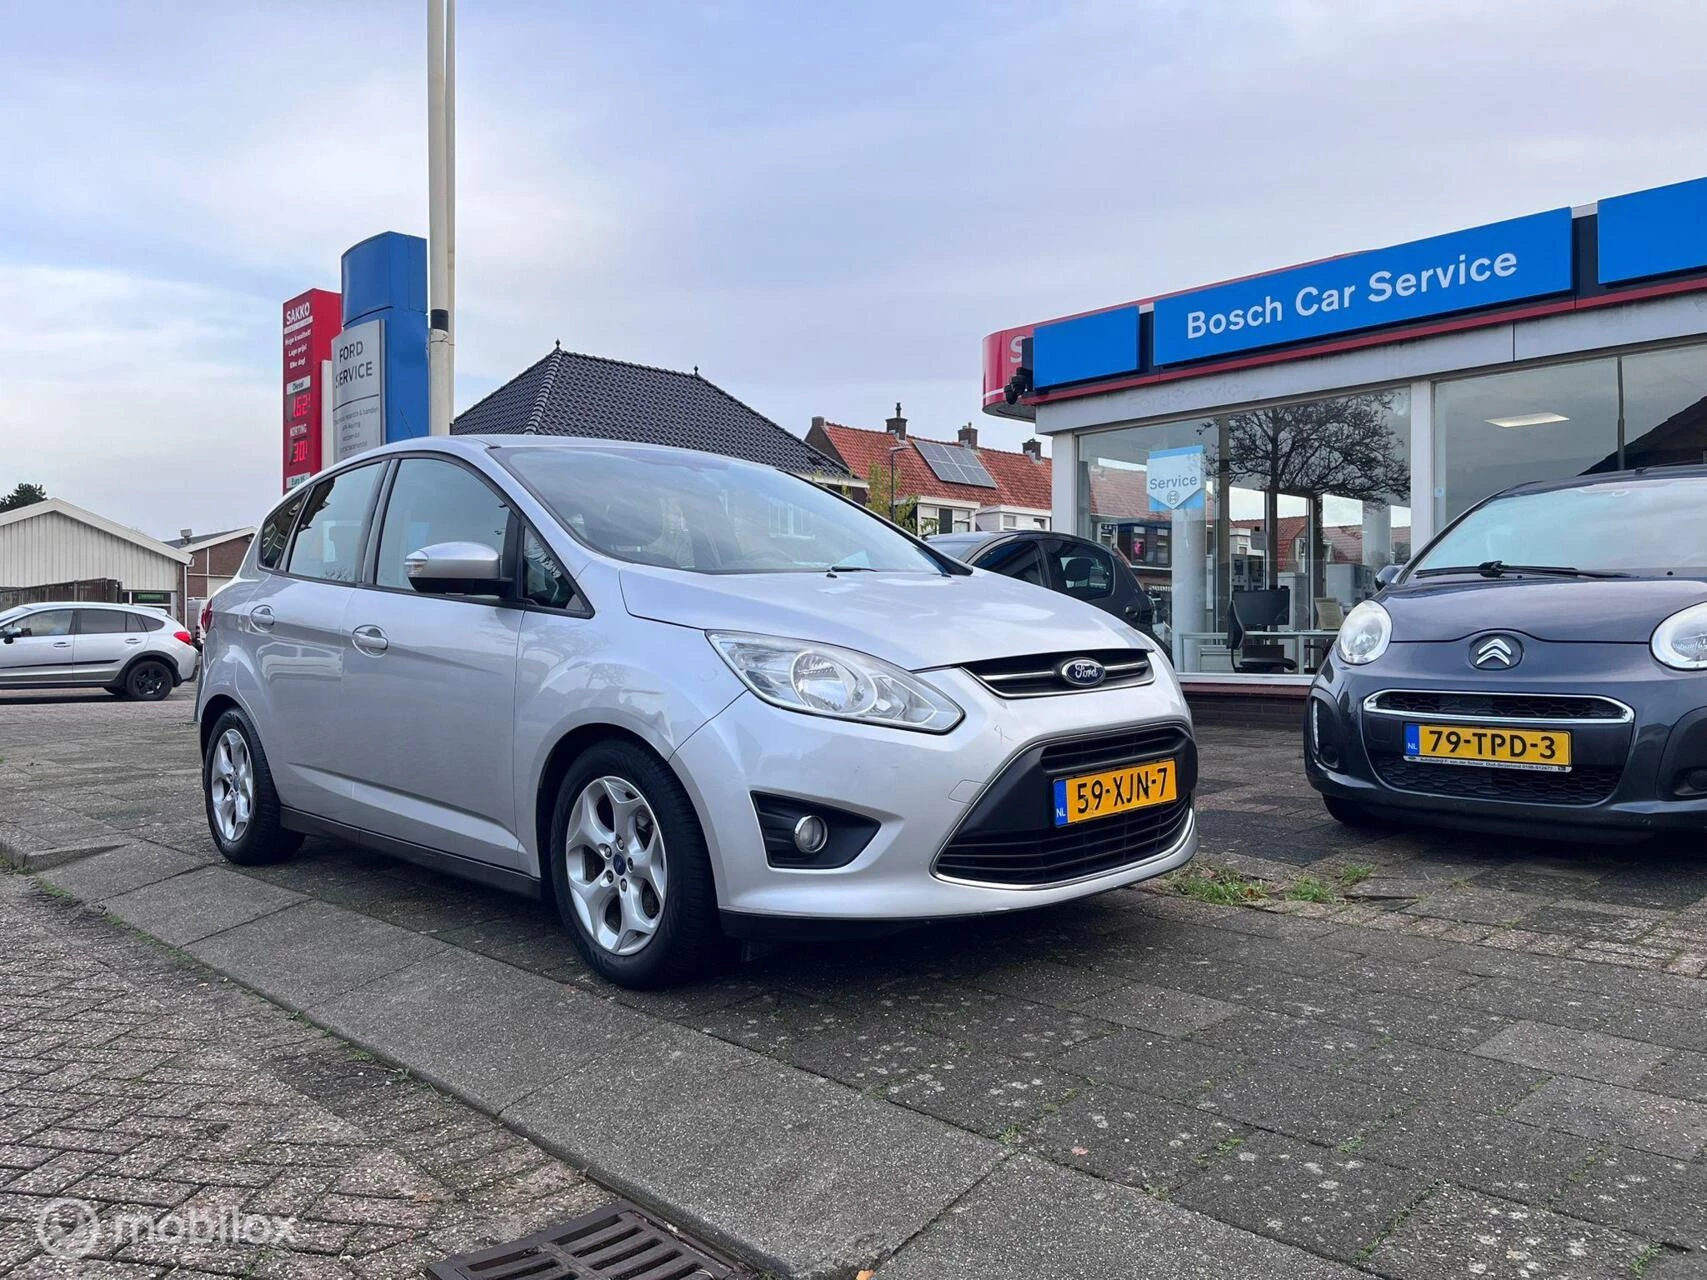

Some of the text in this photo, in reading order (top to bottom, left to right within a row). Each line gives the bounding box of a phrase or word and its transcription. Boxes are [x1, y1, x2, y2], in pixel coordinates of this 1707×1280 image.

[1187, 252, 1517, 339] Bosch Car Service
[286, 302, 310, 325] SAKKO
[339, 340, 363, 363] FORD
[335, 361, 372, 388] SERVICE
[1150, 475, 1197, 490] Service
[1074, 664, 1098, 679] Ford
[1408, 743, 1417, 751] NL
[1428, 730, 1556, 759] 79-TPD-3
[1077, 767, 1167, 814] 59-XJN-7
[1056, 809, 1066, 818] NL
